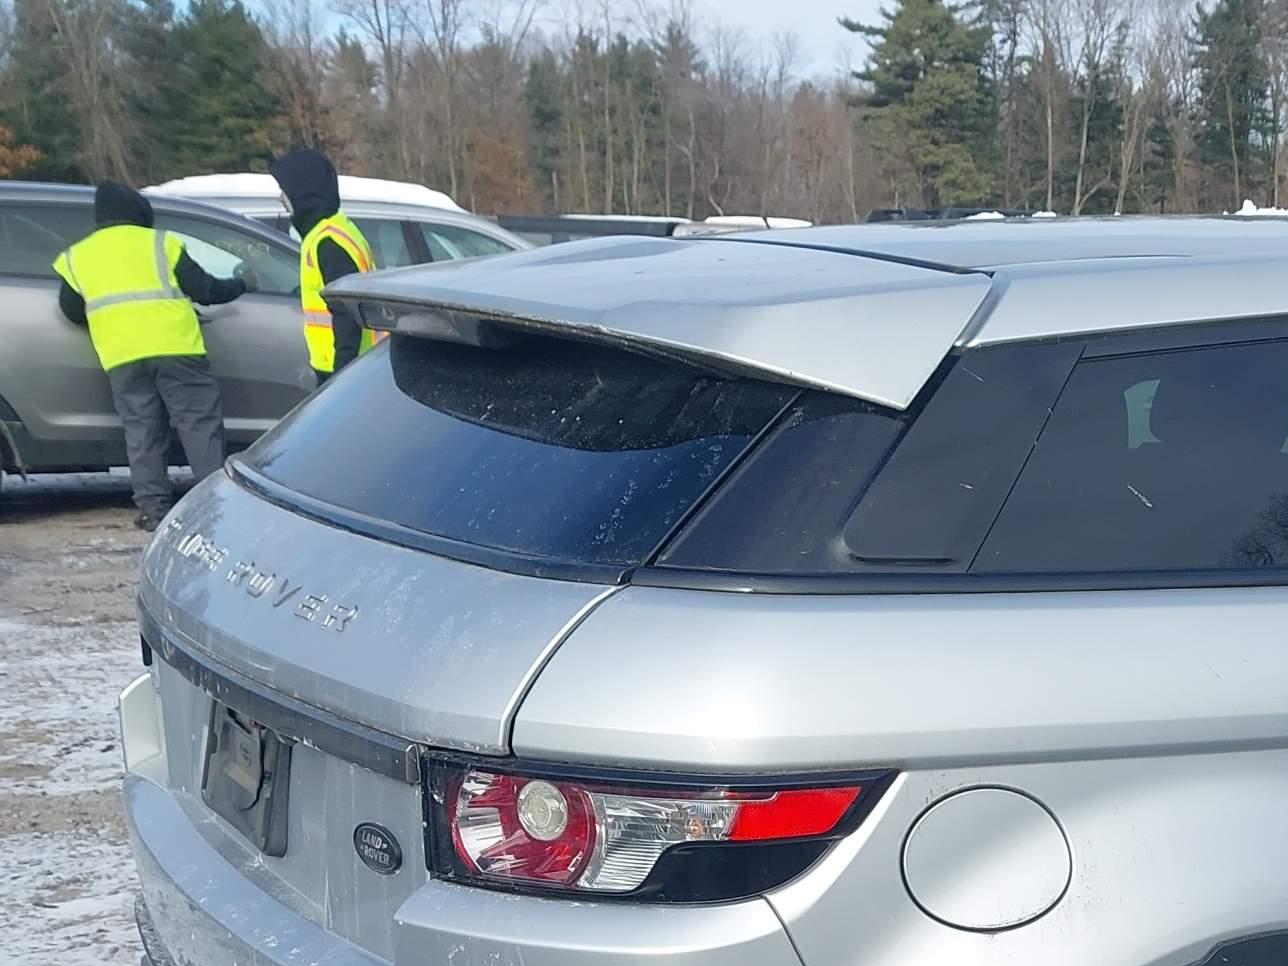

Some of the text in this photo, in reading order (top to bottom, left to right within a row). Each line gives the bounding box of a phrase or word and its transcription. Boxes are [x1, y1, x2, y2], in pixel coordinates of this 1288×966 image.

[226, 561, 359, 632] ROVER
[361, 830, 382, 849] LAND
[364, 844, 390, 866] ROVER
